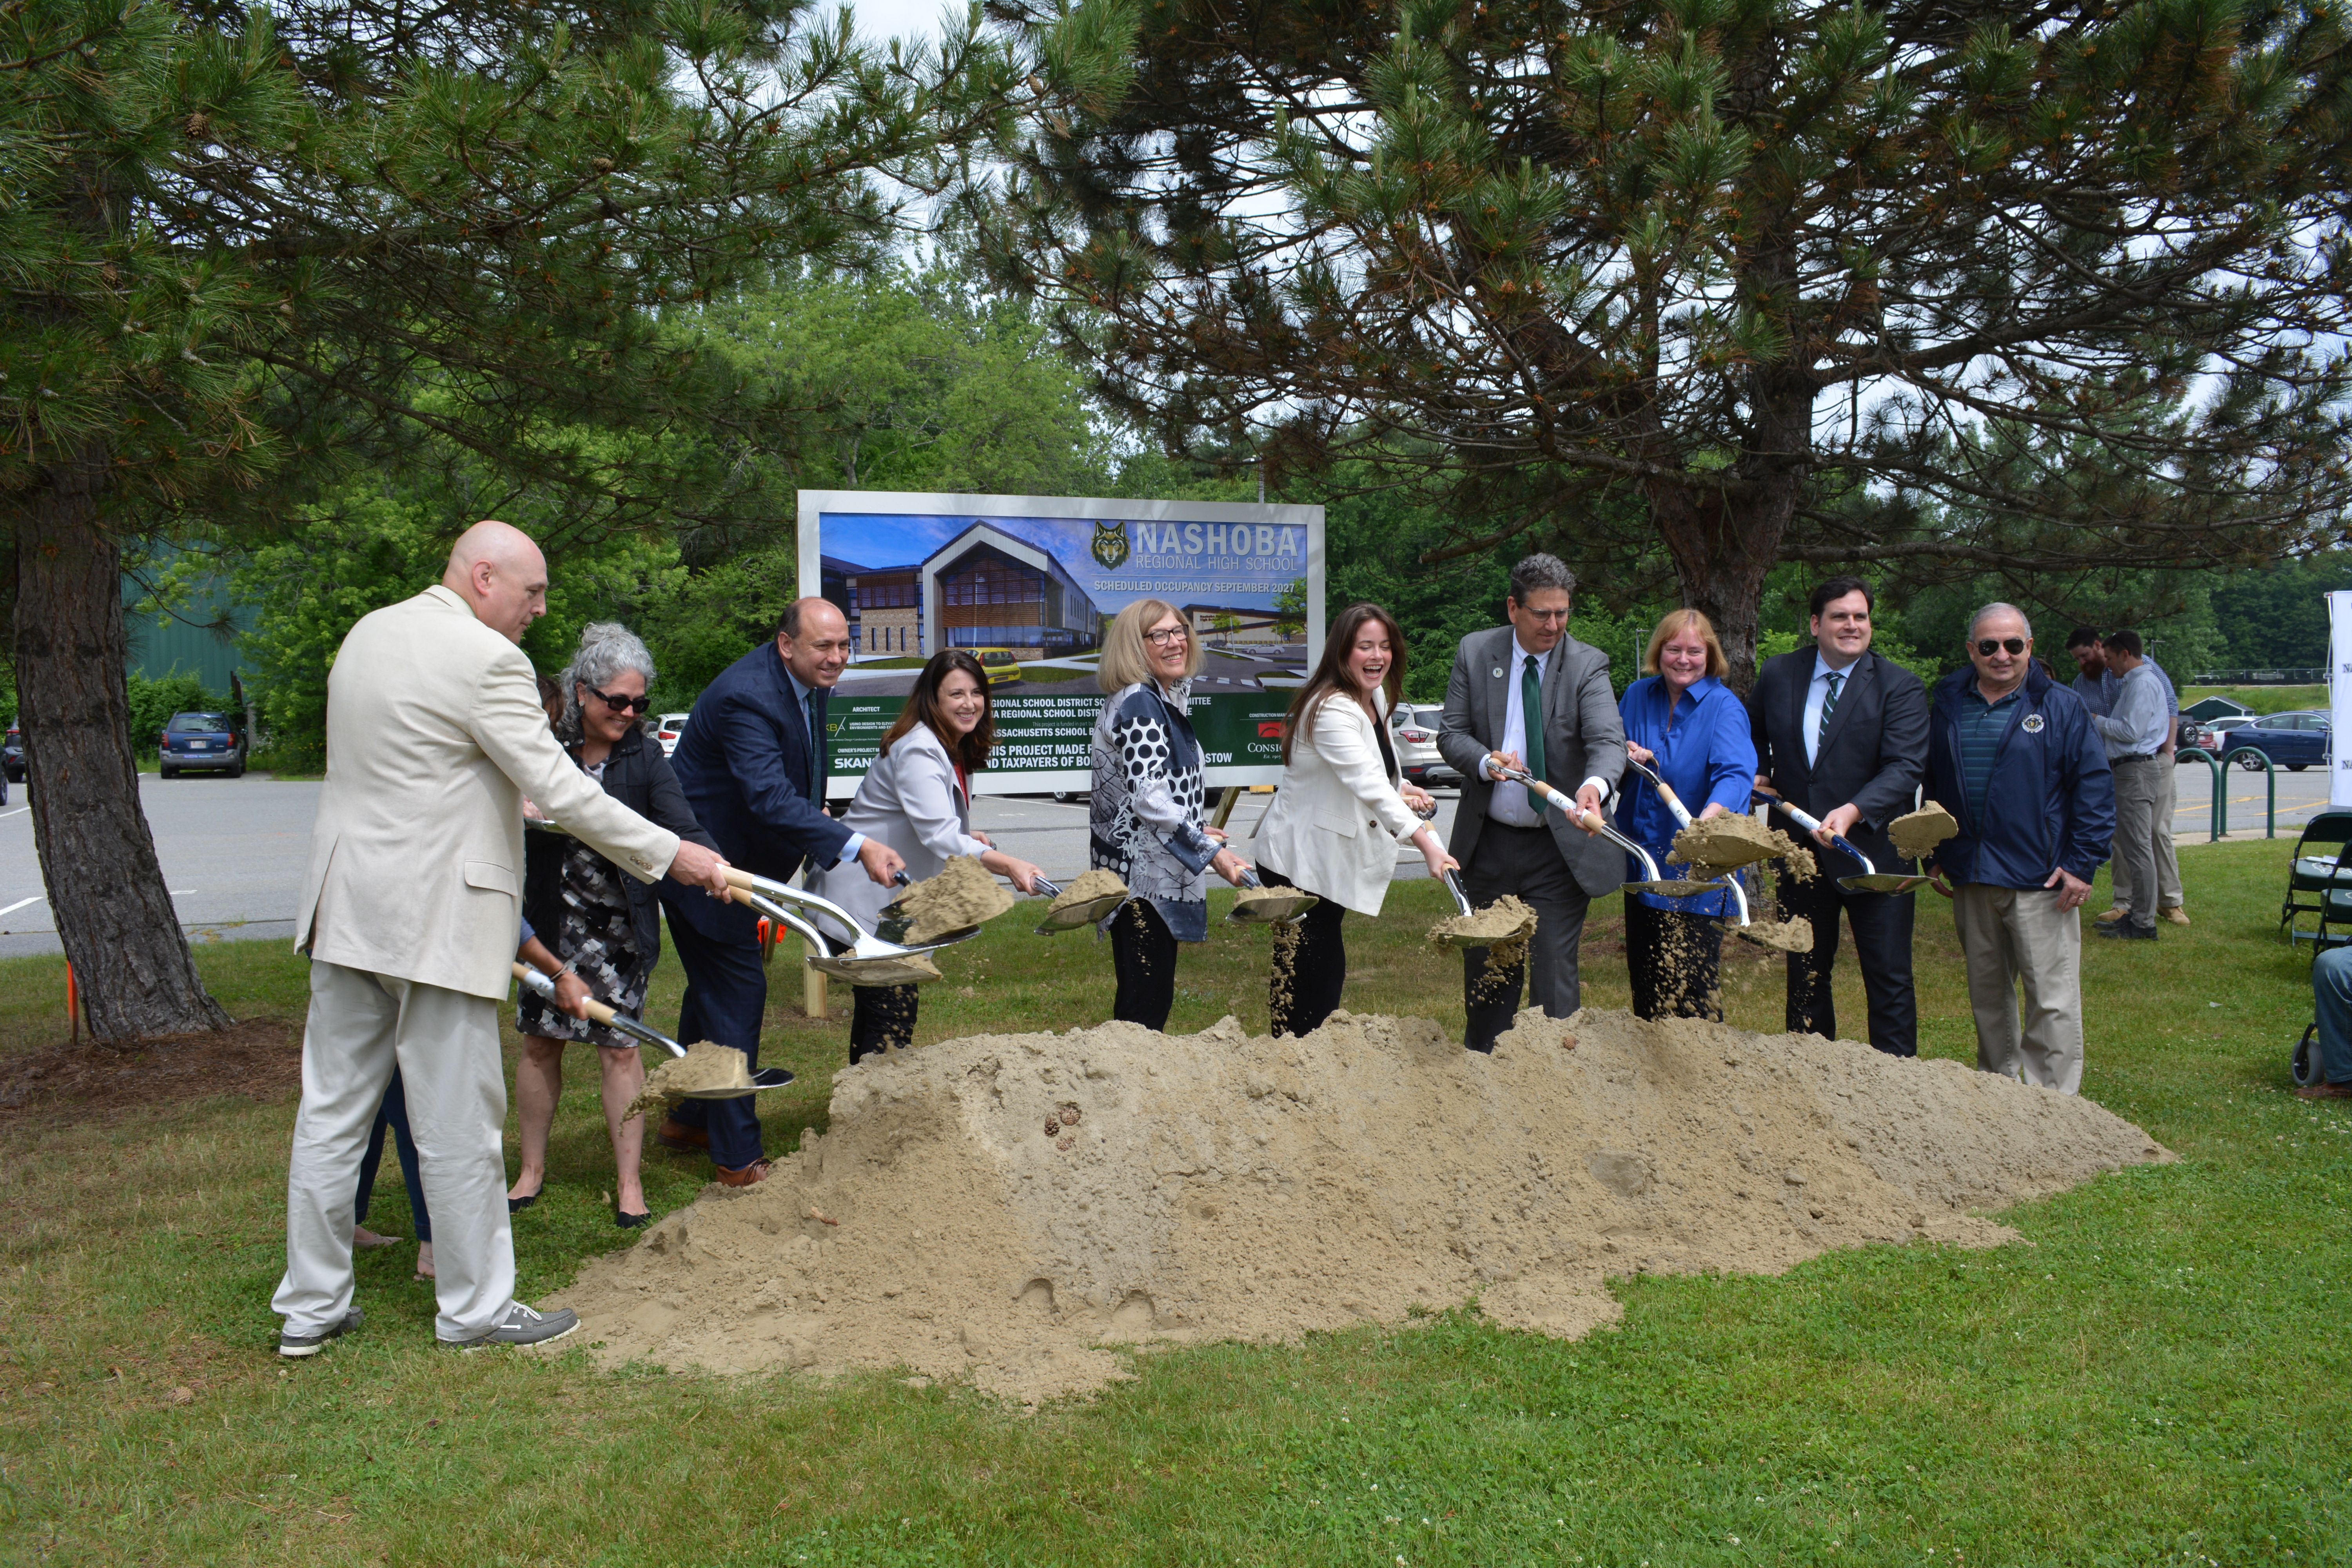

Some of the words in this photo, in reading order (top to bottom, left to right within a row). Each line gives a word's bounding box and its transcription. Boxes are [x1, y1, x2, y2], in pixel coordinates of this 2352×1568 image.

[1137, 523, 1298, 557] NASHOBA
[1137, 555, 1201, 569] REGIONAL
[1209, 557, 1239, 570] HIGH
[1246, 557, 1298, 571] SCHOOL
[1094, 581, 1153, 592] SCHEDULED
[1155, 581, 1213, 592] OCCUPANCY
[1215, 582, 1270, 593] SEPTEMBER
[1272, 583, 1295, 593] 2027
[989, 699, 1022, 708] GIONAL
[1023, 699, 1056, 707] SCHOOL
[1057, 698, 1093, 707] DISTRICT
[1001, 710, 1042, 718] REGIONAL
[1043, 709, 1076, 718] SCHOOL
[1055, 728, 1087, 737] SCHOOL
[1009, 745, 1053, 756] PROJECT
[1055, 744, 1085, 755] MADE
[835, 757, 874, 768] SKAN
[1001, 757, 1058, 768] TAXPAYERS
[1060, 756, 1074, 767] OF
[1205, 752, 1232, 763] STOW
